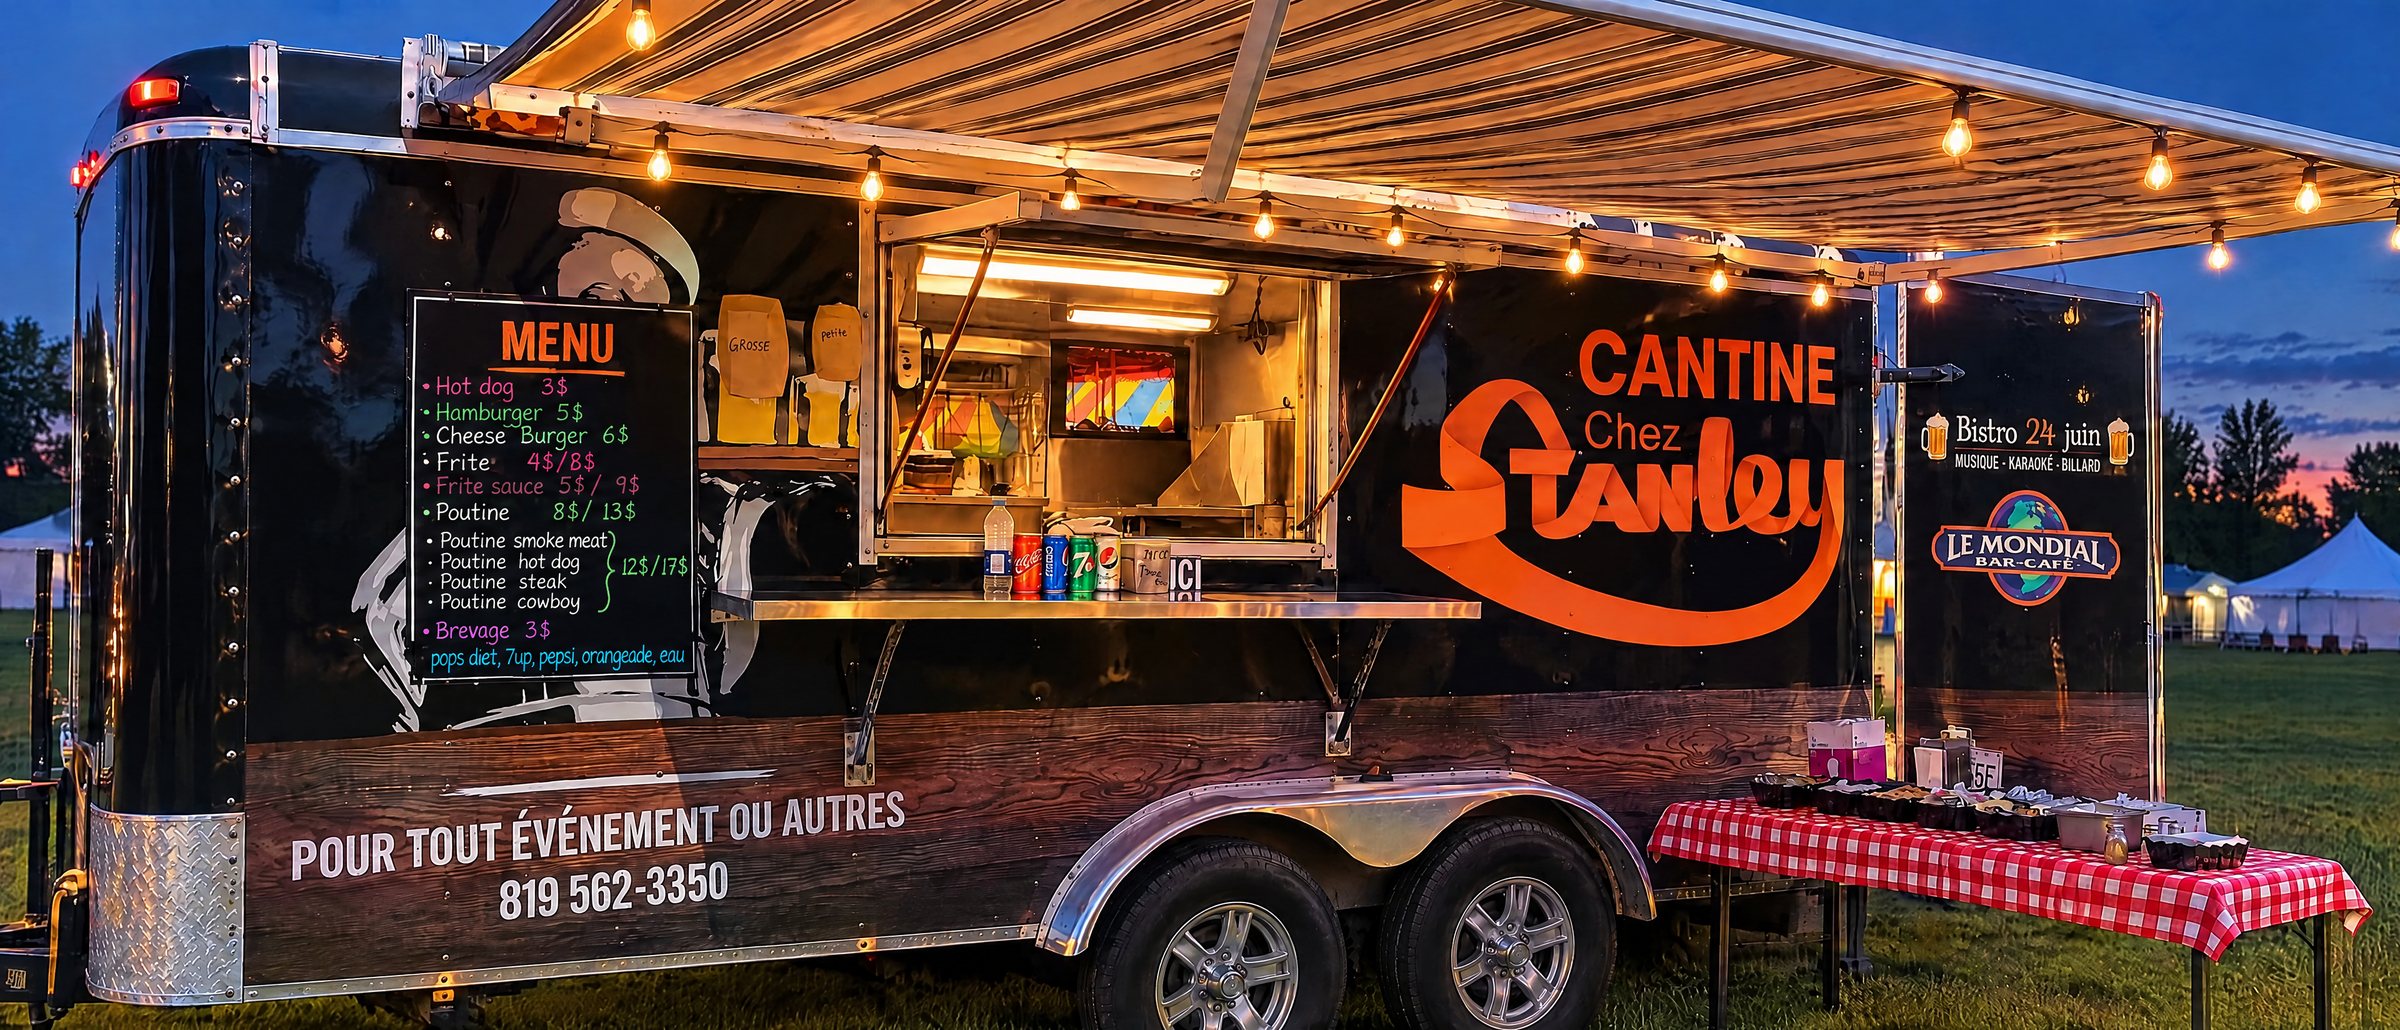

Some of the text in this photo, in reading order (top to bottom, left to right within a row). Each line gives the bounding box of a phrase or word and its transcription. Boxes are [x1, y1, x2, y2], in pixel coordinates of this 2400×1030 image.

[502, 320, 614, 364] MENU
[729, 336, 770, 352] GROSSE
[1579, 328, 1836, 406] CANTINE
[436, 376, 568, 403] Hot dog 3$
[436, 402, 583, 428] Hamburger 5$
[436, 424, 629, 450] Cheese Burger 6$
[1584, 410, 1682, 452] Chez
[1956, 415, 2101, 453] Bistro 24 juin
[437, 452, 490, 472] Frite
[1955, 453, 2000, 470] MUSIQUE
[2008, 454, 2054, 472] KARAOKÉ
[2061, 457, 2101, 473] BILLARD
[436, 476, 483, 495] Frite
[491, 481, 544, 494] sauce
[615, 474, 640, 495] 9$
[436, 502, 510, 521] Poutine
[602, 500, 637, 522] 13$
[440, 531, 608, 549] Poutine smoke meat
[1947, 534, 2105, 570] LE MONDIAL
[440, 553, 580, 575] Poutine hot dog
[1170, 559, 1201, 590] ICI
[440, 573, 567, 590] Poutine steak
[440, 593, 581, 615] Poutine cowboy
[435, 620, 551, 645] Brevage 3$
[431, 645, 685, 674] pops diet, 7up, pepsi, orangeade, eau
[291, 790, 906, 882] POUR TOUT ÉVÉNEMENT OU AUTRES
[500, 861, 729, 920] 819 562-3350
